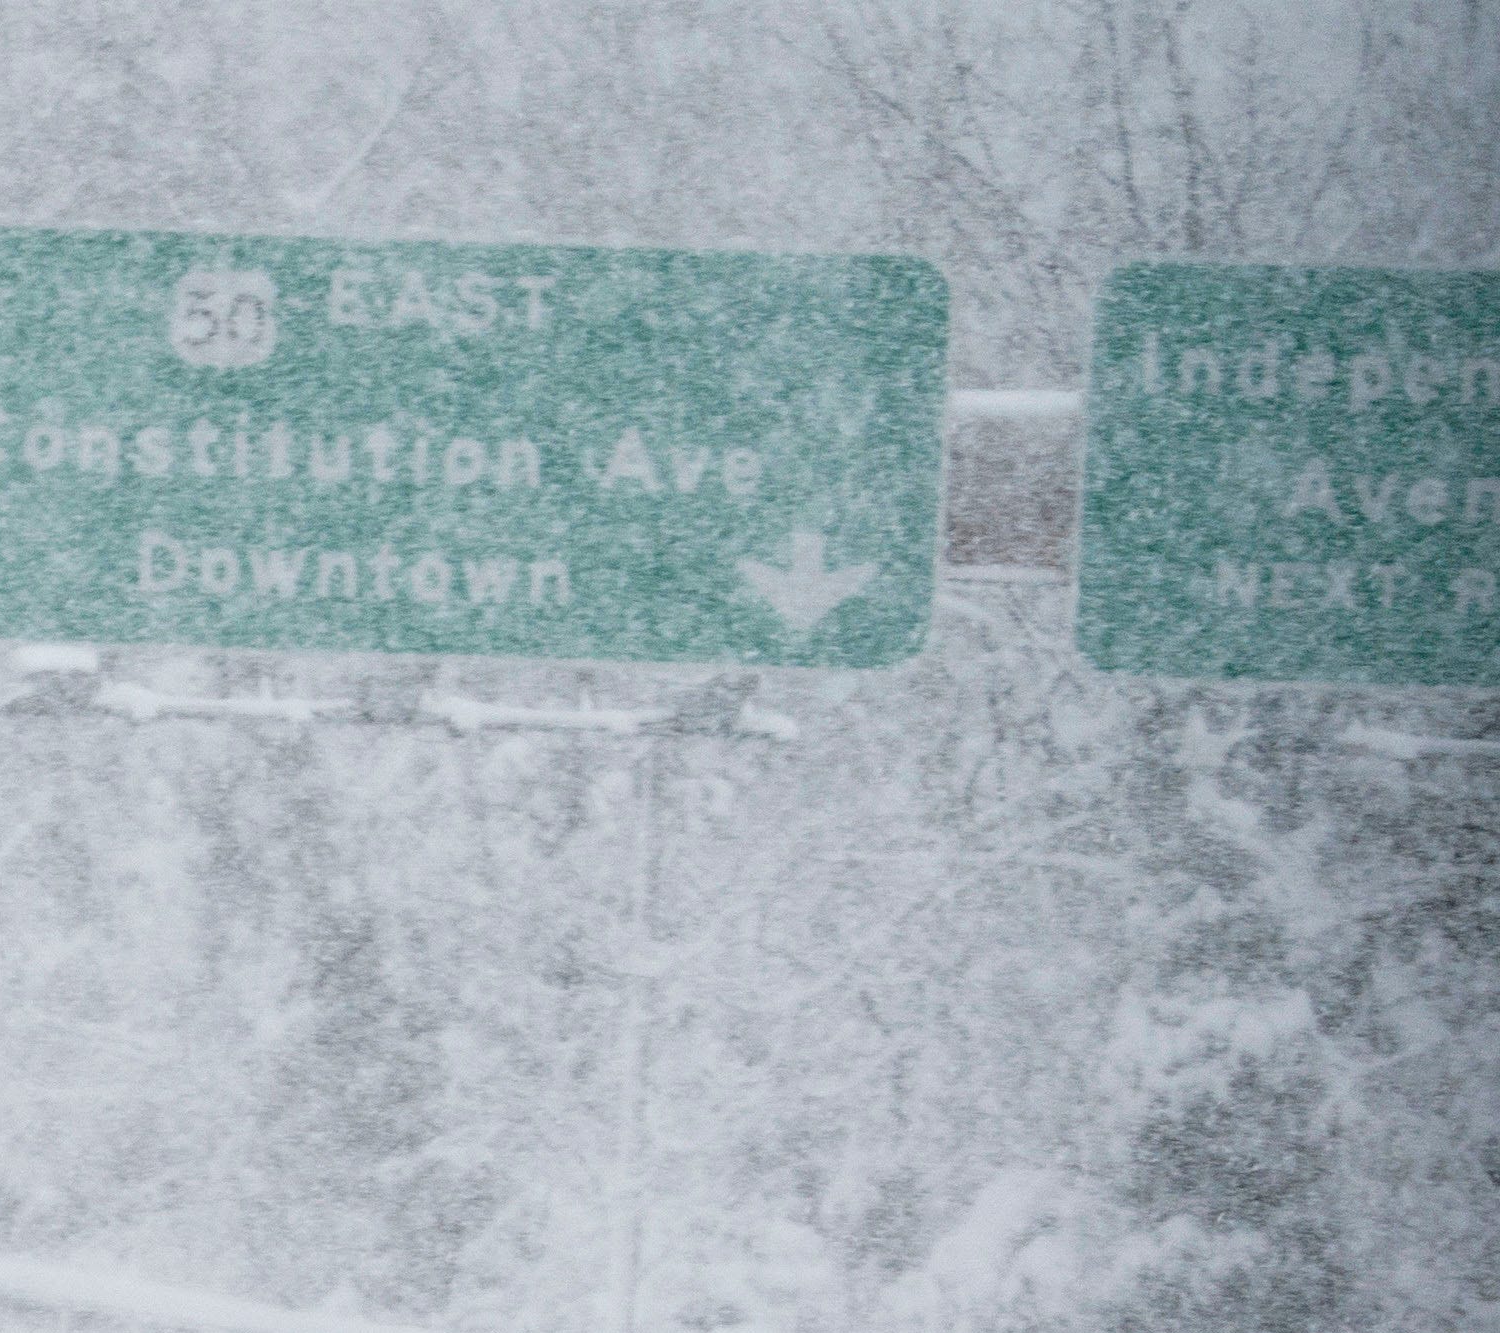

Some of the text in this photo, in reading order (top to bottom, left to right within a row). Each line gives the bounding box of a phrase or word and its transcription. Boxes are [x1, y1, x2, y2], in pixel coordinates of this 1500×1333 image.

[326, 268, 556, 334] EAST
[598, 428, 764, 496] Ave
[132, 530, 570, 602] Downtown
